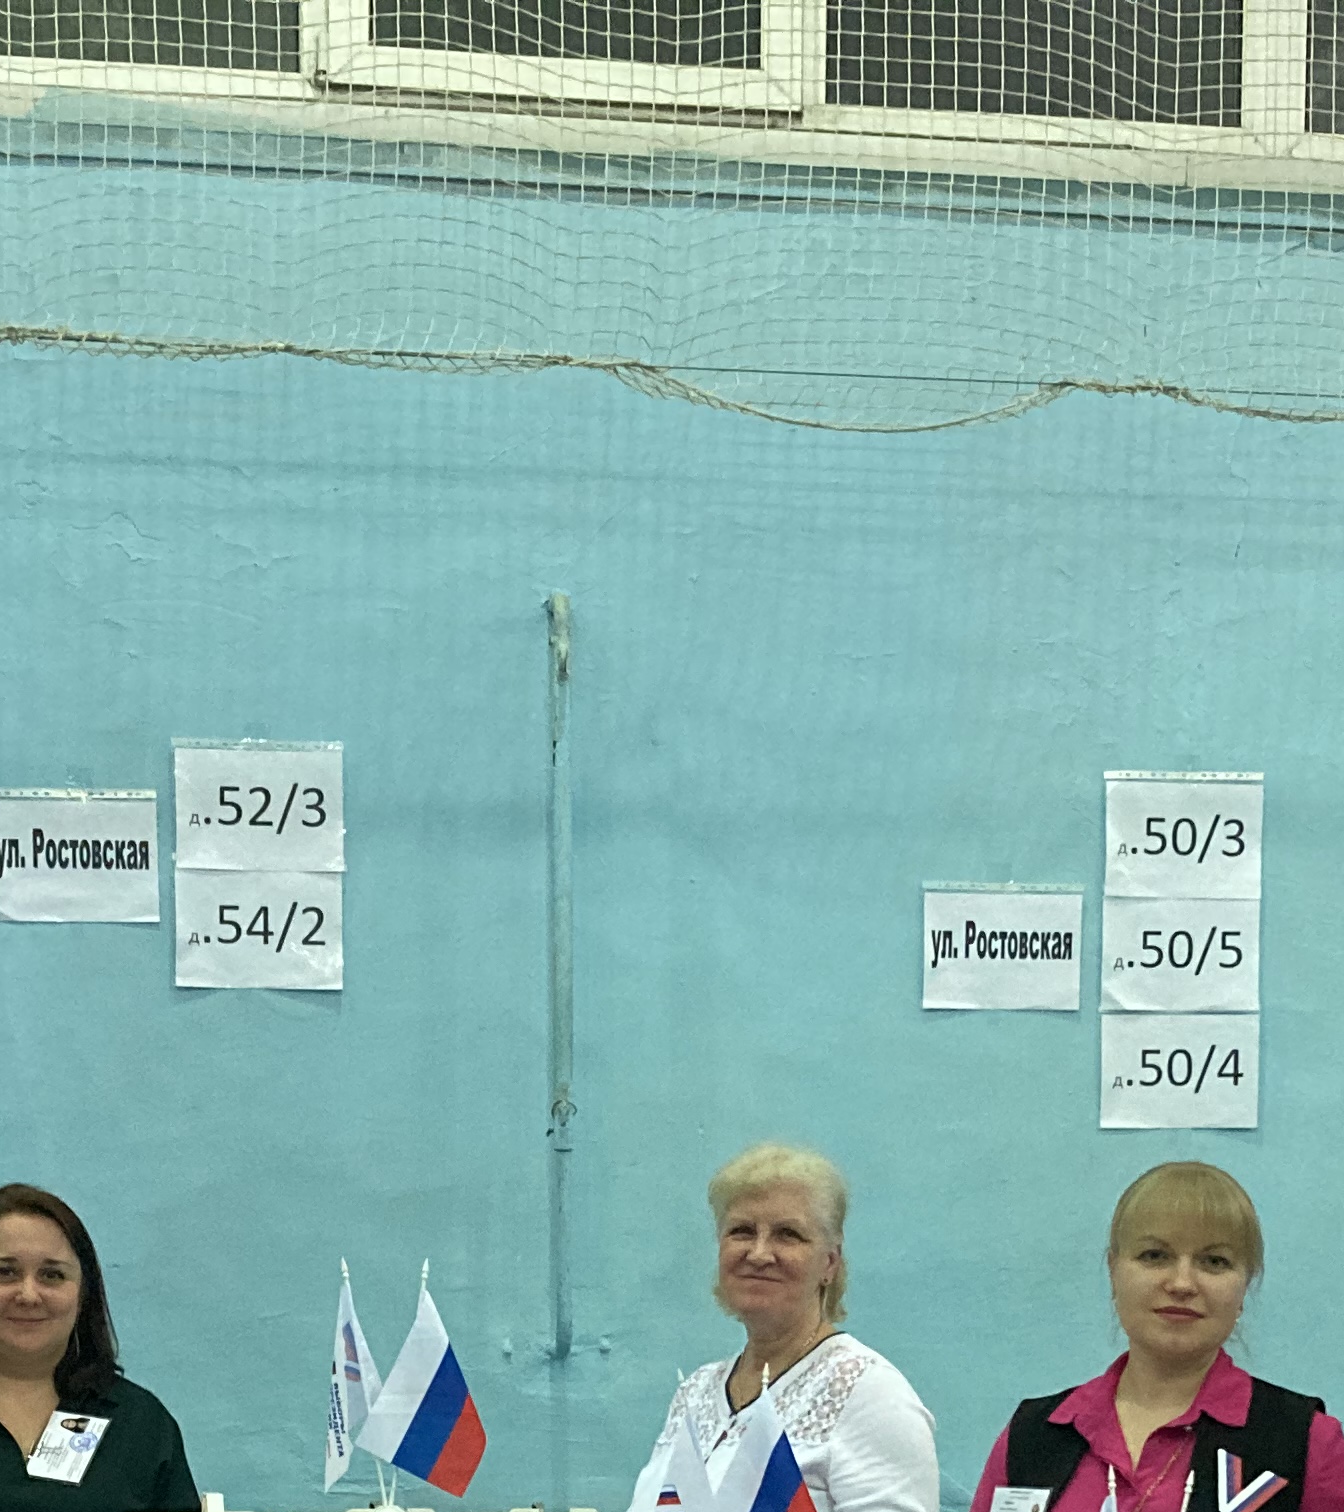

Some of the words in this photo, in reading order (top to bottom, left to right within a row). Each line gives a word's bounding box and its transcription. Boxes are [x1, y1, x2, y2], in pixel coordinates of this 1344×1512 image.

[188, 783, 328, 834] д.52/3
[32, 828, 150, 870] Ростовская
[1117, 814, 1246, 863] д.50/3
[188, 901, 326, 953] д.54/2
[931, 929, 958, 968] ул.
[964, 920, 1073, 960] Ростовская
[1113, 926, 1244, 975] д.50/5
[1112, 1044, 1244, 1094] д.50/4
